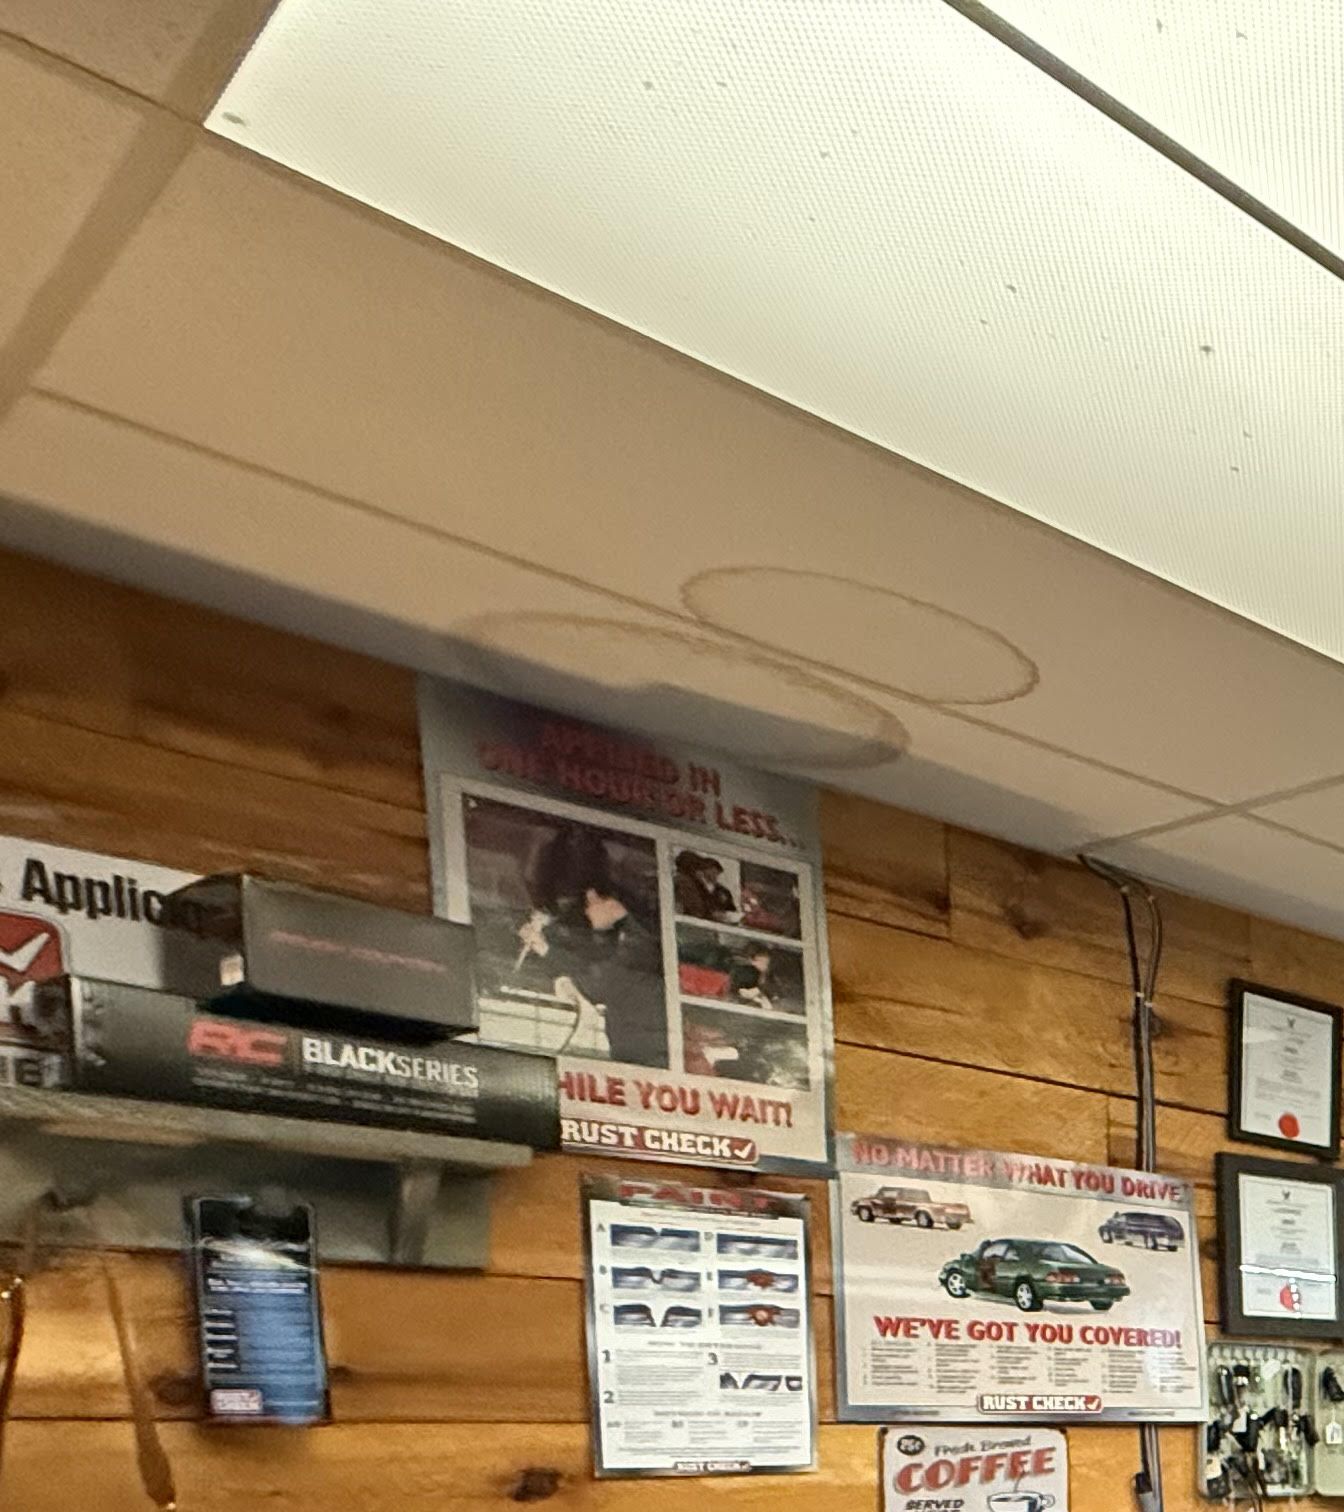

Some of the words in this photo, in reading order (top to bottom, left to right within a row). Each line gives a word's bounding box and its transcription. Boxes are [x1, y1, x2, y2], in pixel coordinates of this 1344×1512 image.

[688, 761, 722, 797] IN
[559, 1071, 626, 1107] HILE
[634, 1079, 701, 1116] YOU
[561, 1119, 639, 1148] RUST
[643, 1128, 732, 1158] CHECK
[852, 1138, 889, 1166] NO
[897, 1146, 996, 1179] MATTER
[1002, 1160, 1068, 1191] WHAT
[1071, 1168, 1115, 1194] YOU
[872, 1315, 961, 1342] WE'VE
[966, 1319, 1017, 1343] GOT
[1024, 1322, 1074, 1345] YOU
[1079, 1324, 1183, 1349] COVERED!
[982, 1395, 1031, 1412] RUST
[1033, 1395, 1087, 1412] CHECK
[894, 1446, 1057, 1496] COFFEE
[905, 1499, 965, 1511] SERVED
